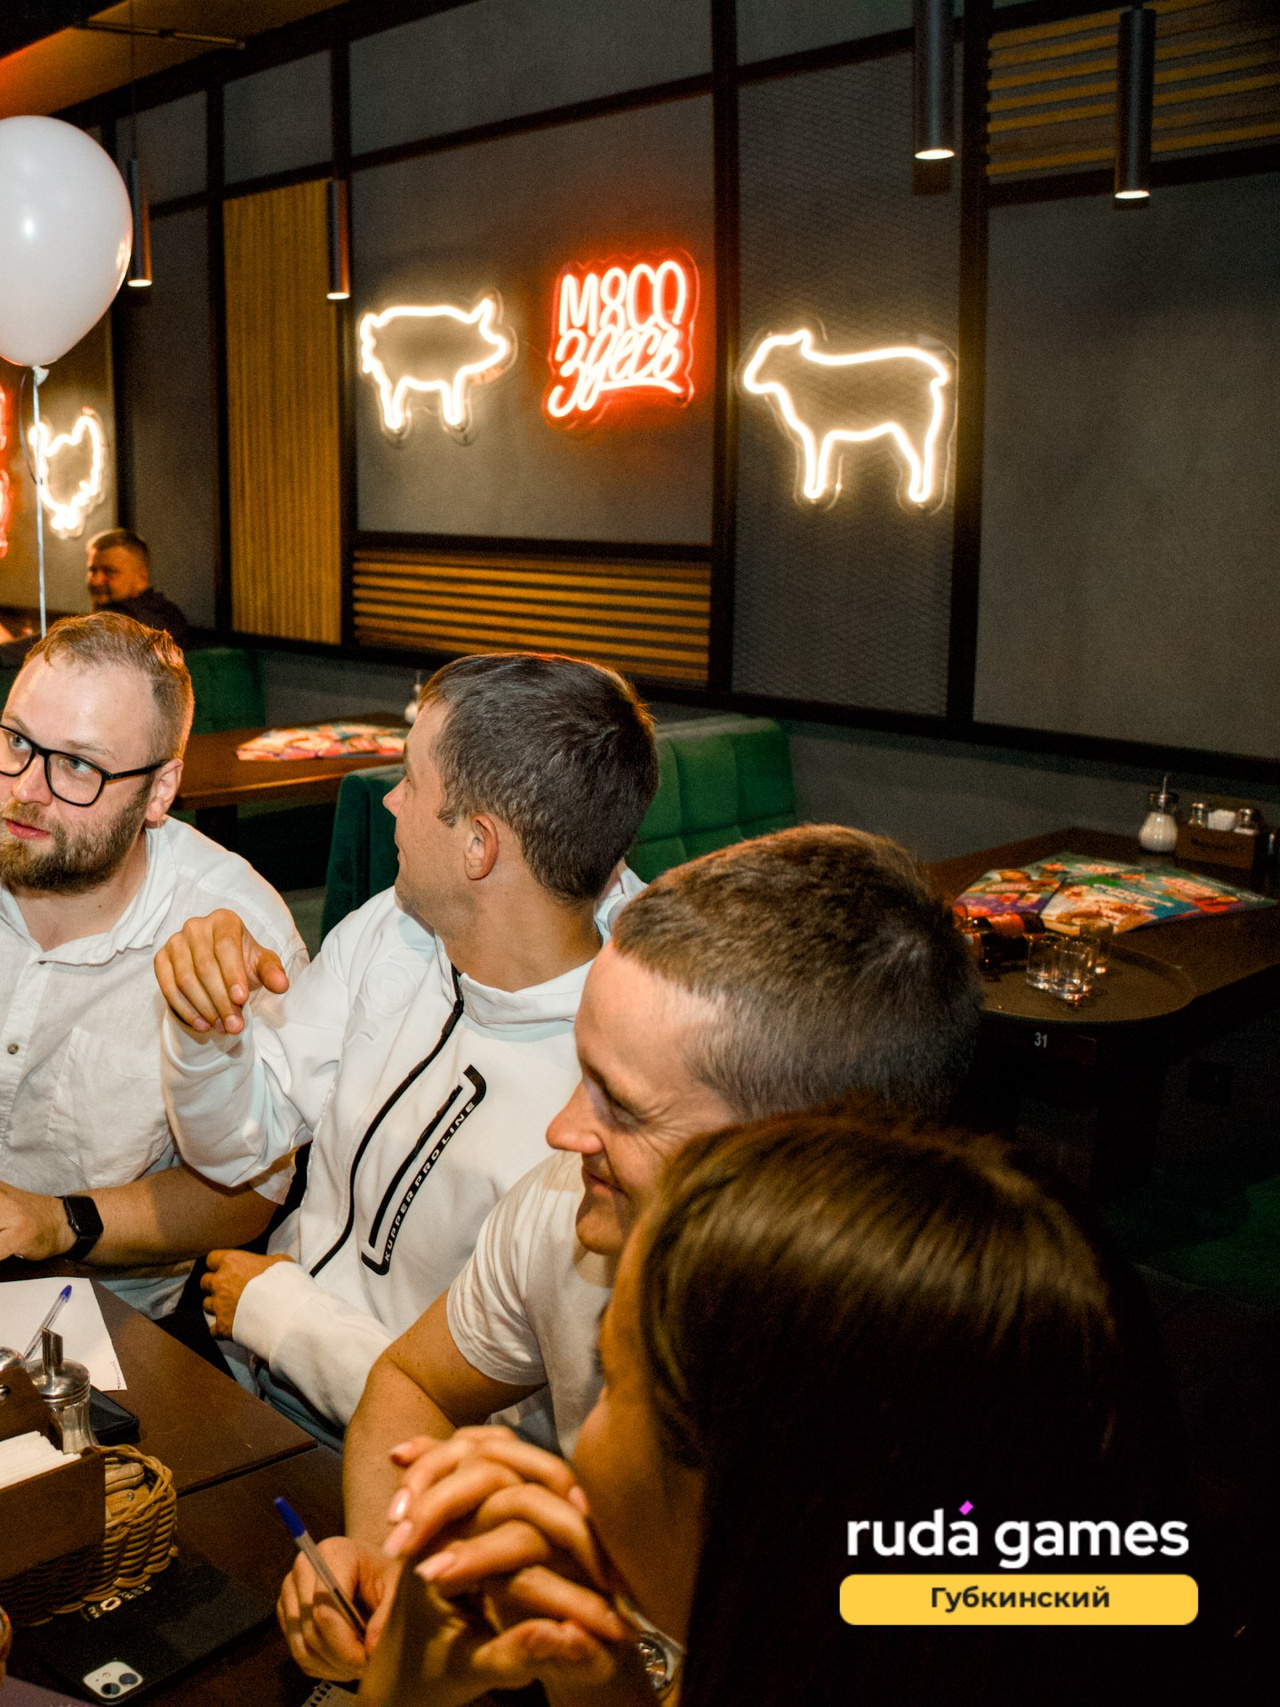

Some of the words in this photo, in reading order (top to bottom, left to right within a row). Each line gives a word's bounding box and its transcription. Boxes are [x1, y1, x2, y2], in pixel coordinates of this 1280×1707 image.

[1034, 1032, 1048, 1048] 31
[385, 1191, 414, 1262] KUPPER
[415, 1149, 440, 1187] PRO
[441, 1102, 475, 1146] LINE
